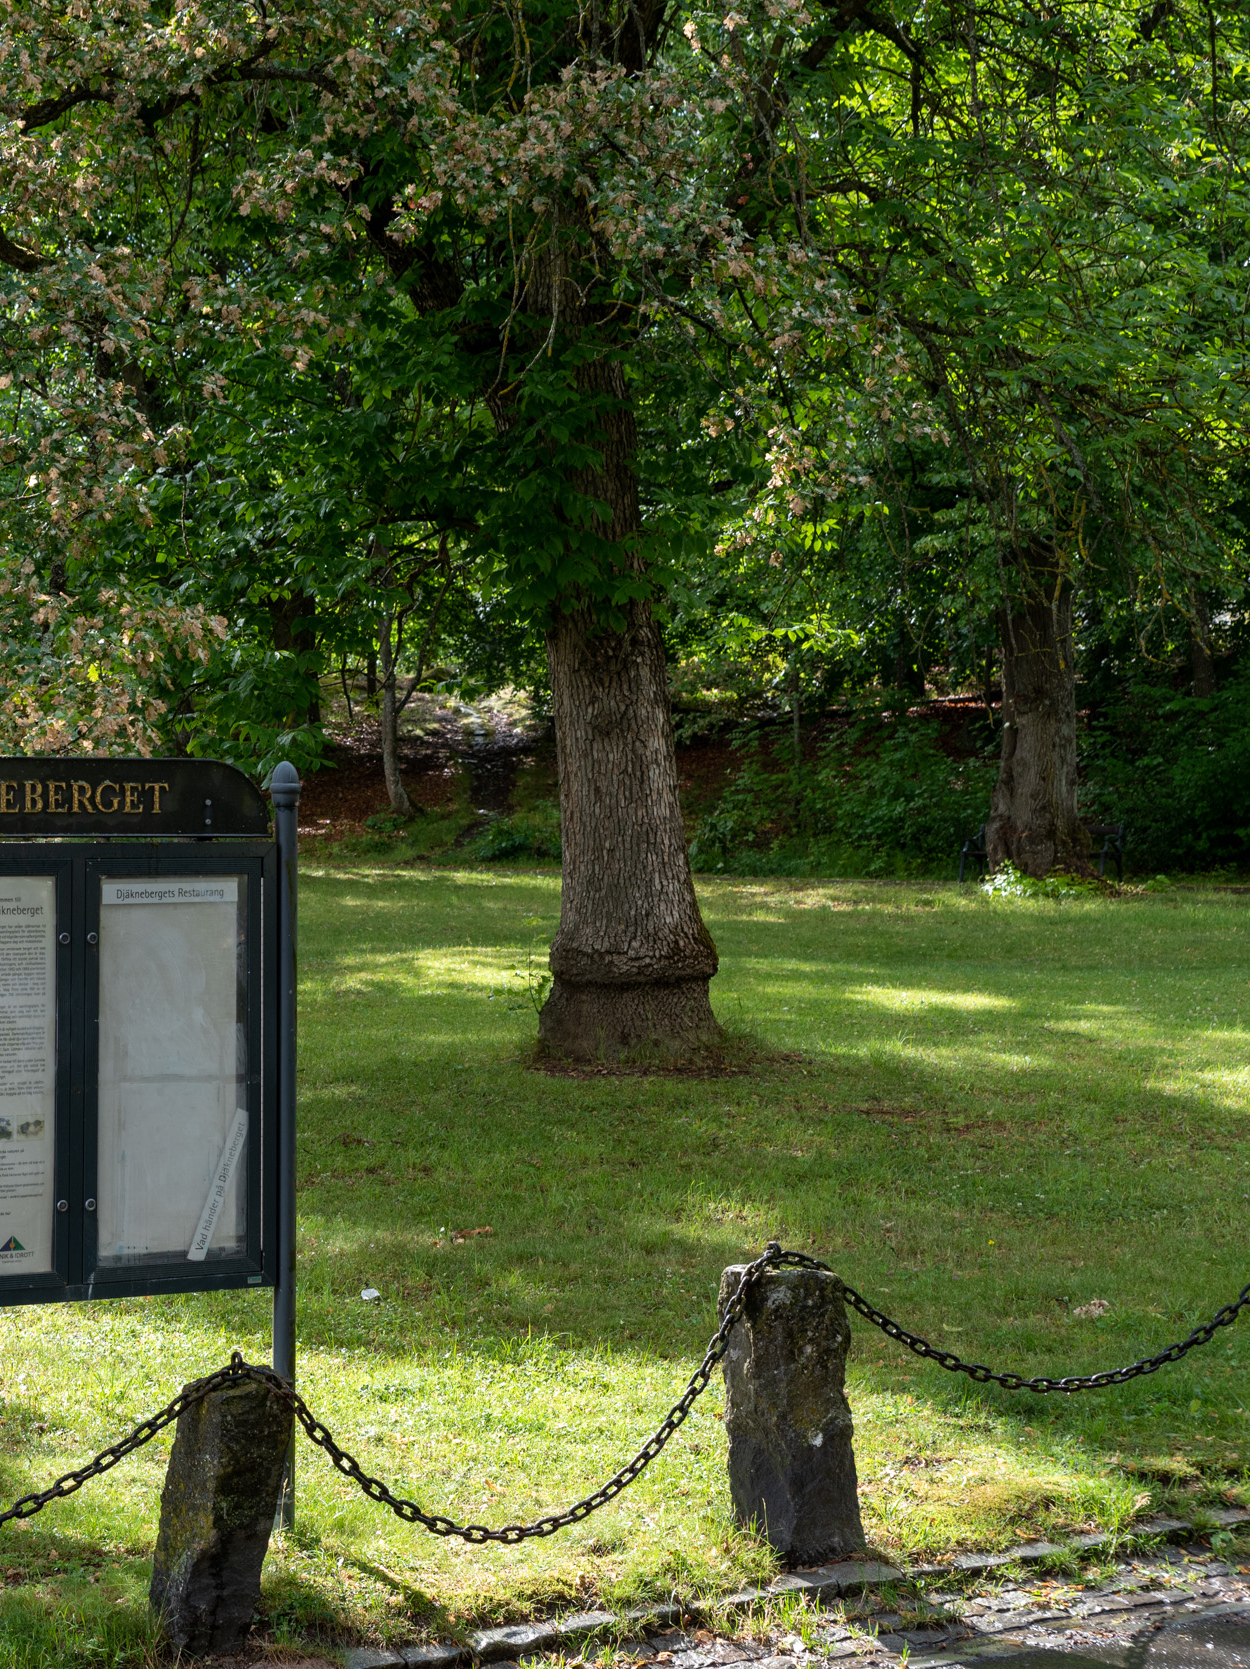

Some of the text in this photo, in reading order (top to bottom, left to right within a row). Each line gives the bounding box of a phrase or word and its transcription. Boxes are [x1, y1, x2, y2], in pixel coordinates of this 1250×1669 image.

[116, 887, 225, 902] Djäknebergets Restaurang
[195, 1121, 246, 1251] Vad händer på Djäkneberget
